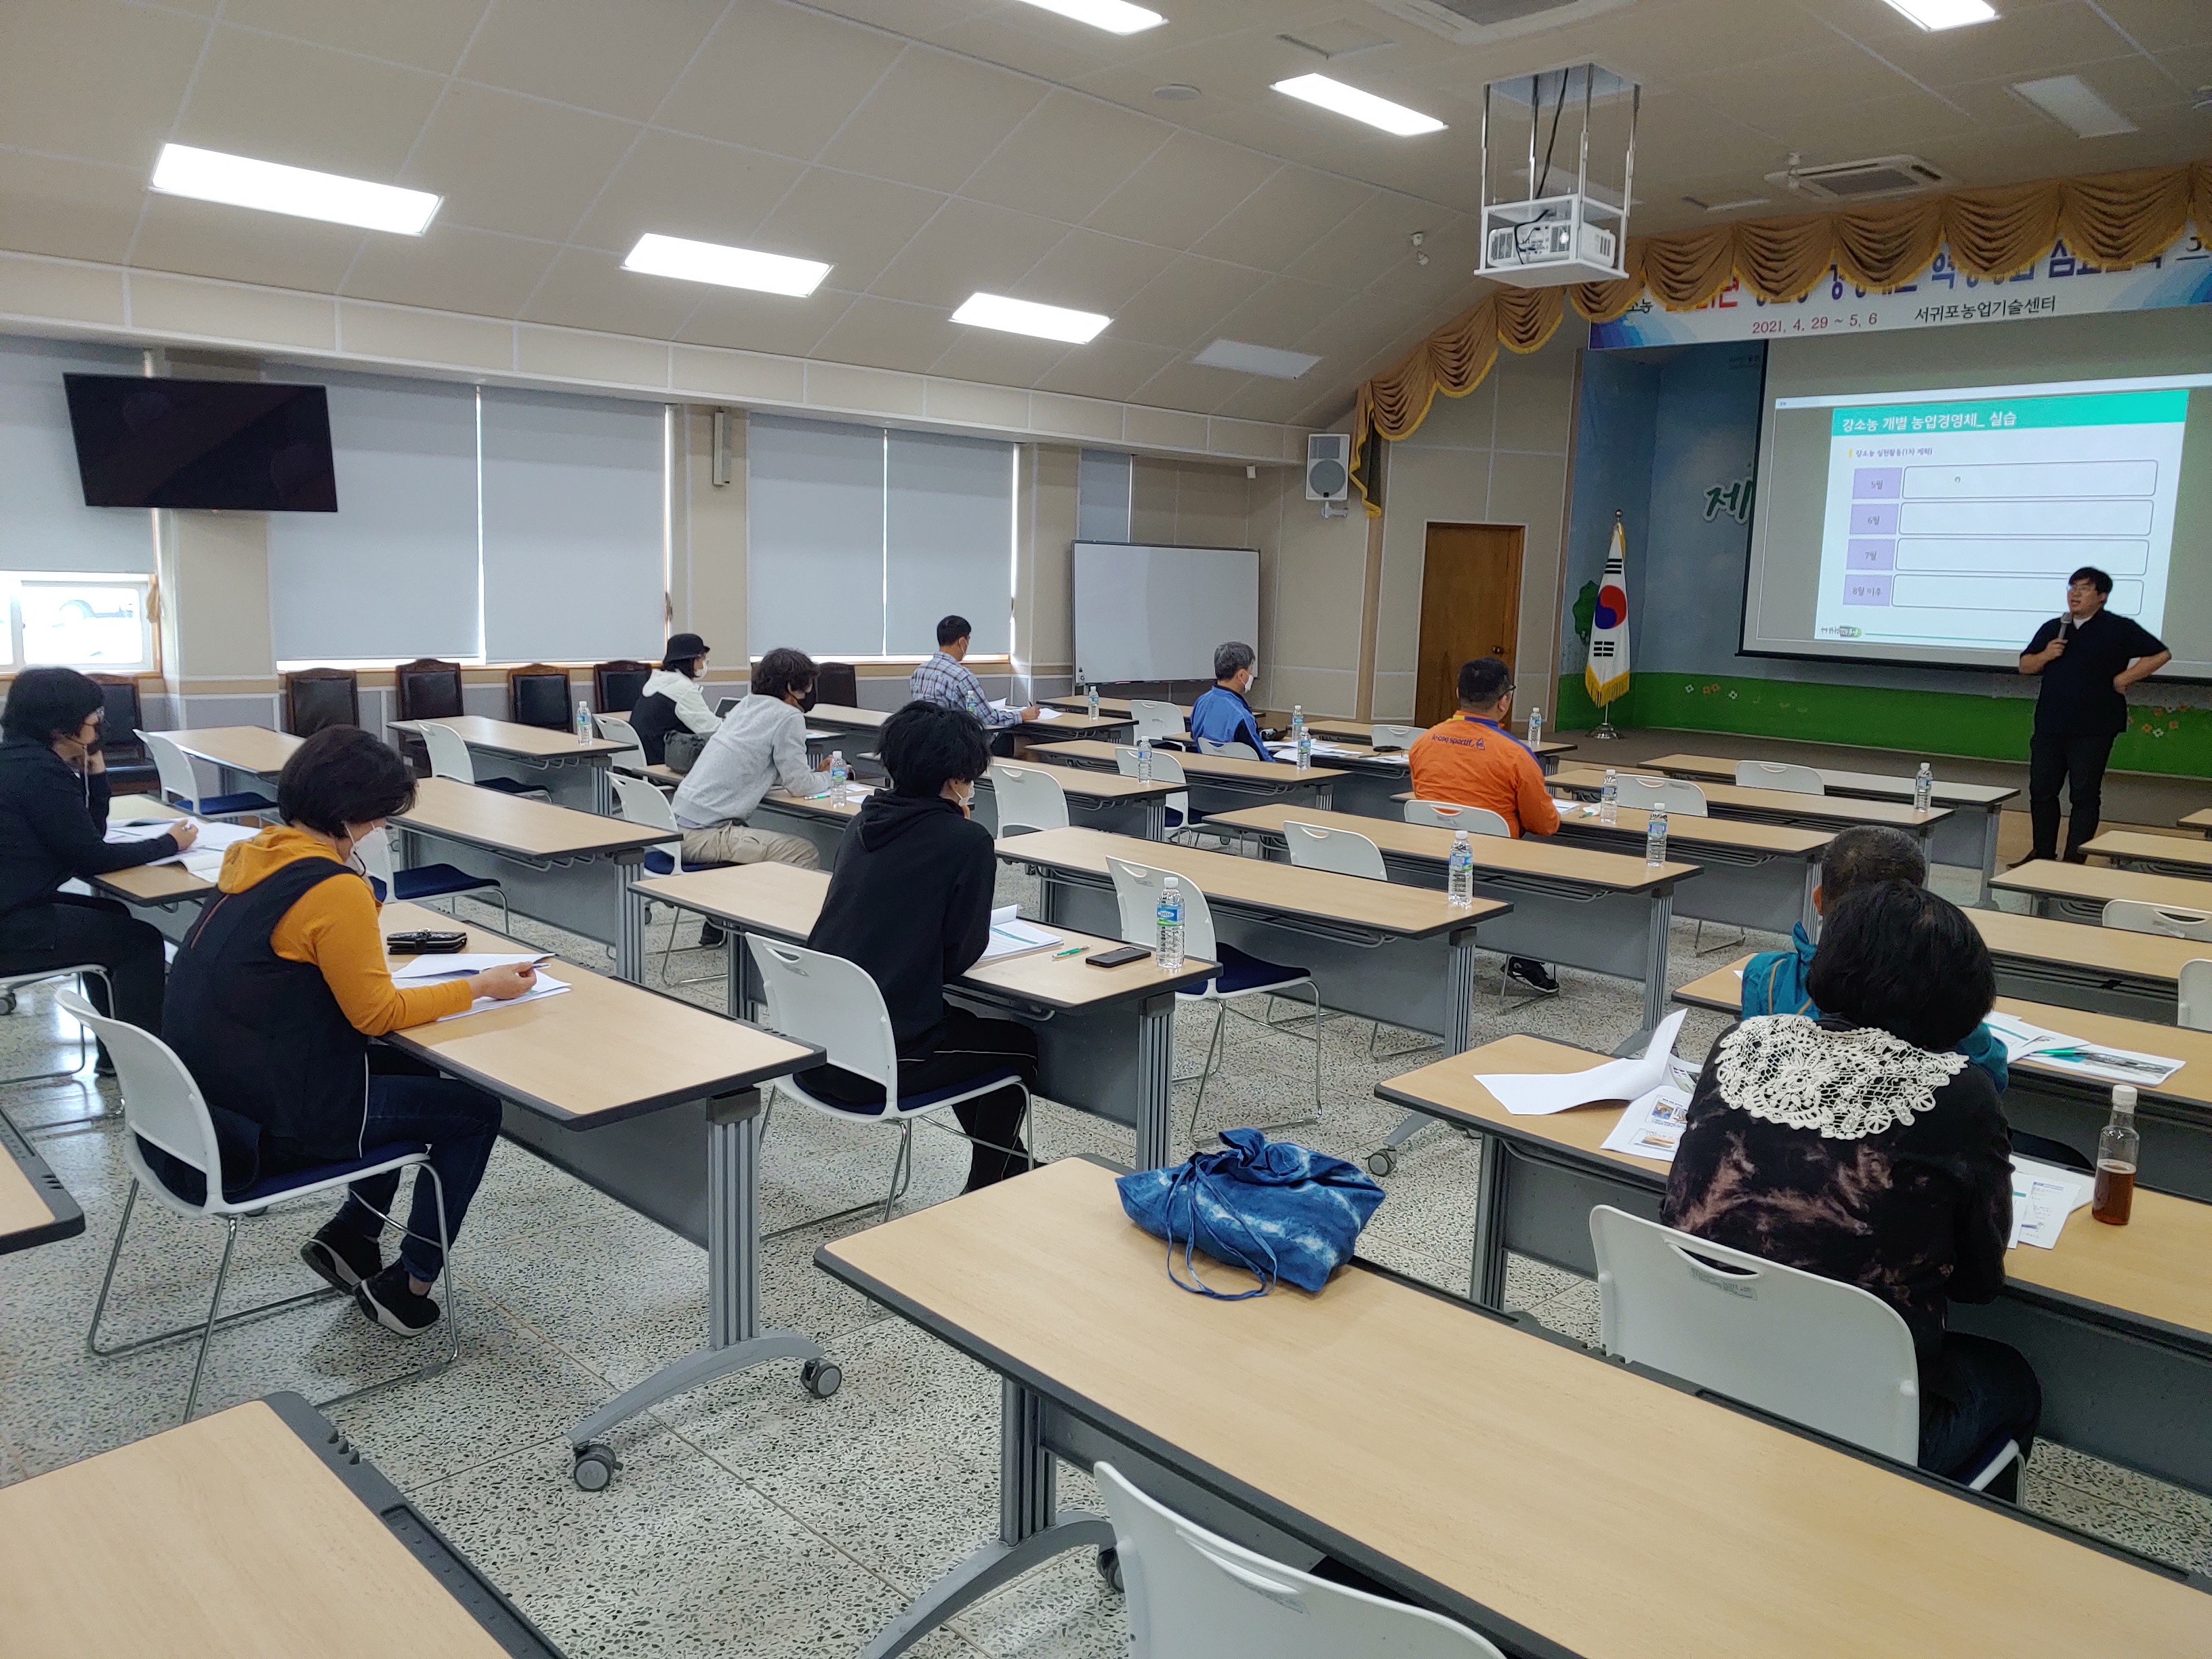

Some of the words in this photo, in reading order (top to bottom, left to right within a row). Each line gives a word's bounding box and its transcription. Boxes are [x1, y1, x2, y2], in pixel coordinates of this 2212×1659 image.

[1793, 318, 1805, 331] 4.
[1811, 316, 1828, 329] 29
[1868, 312, 1877, 325] 6
[1914, 295, 2056, 323] 서귀포농업기술센터
[1843, 418, 1879, 432] 강소농
[1883, 416, 1907, 430] 개별
[1990, 411, 2017, 427] 실습
[1871, 480, 1883, 490] 5월
[1706, 480, 1753, 520] 제
[1868, 516, 1880, 525] 6월
[1865, 550, 1877, 560] 7월
[1852, 586, 1864, 596] 8월
[1867, 587, 1883, 596] 이후
[1450, 737, 1473, 745] sportif
